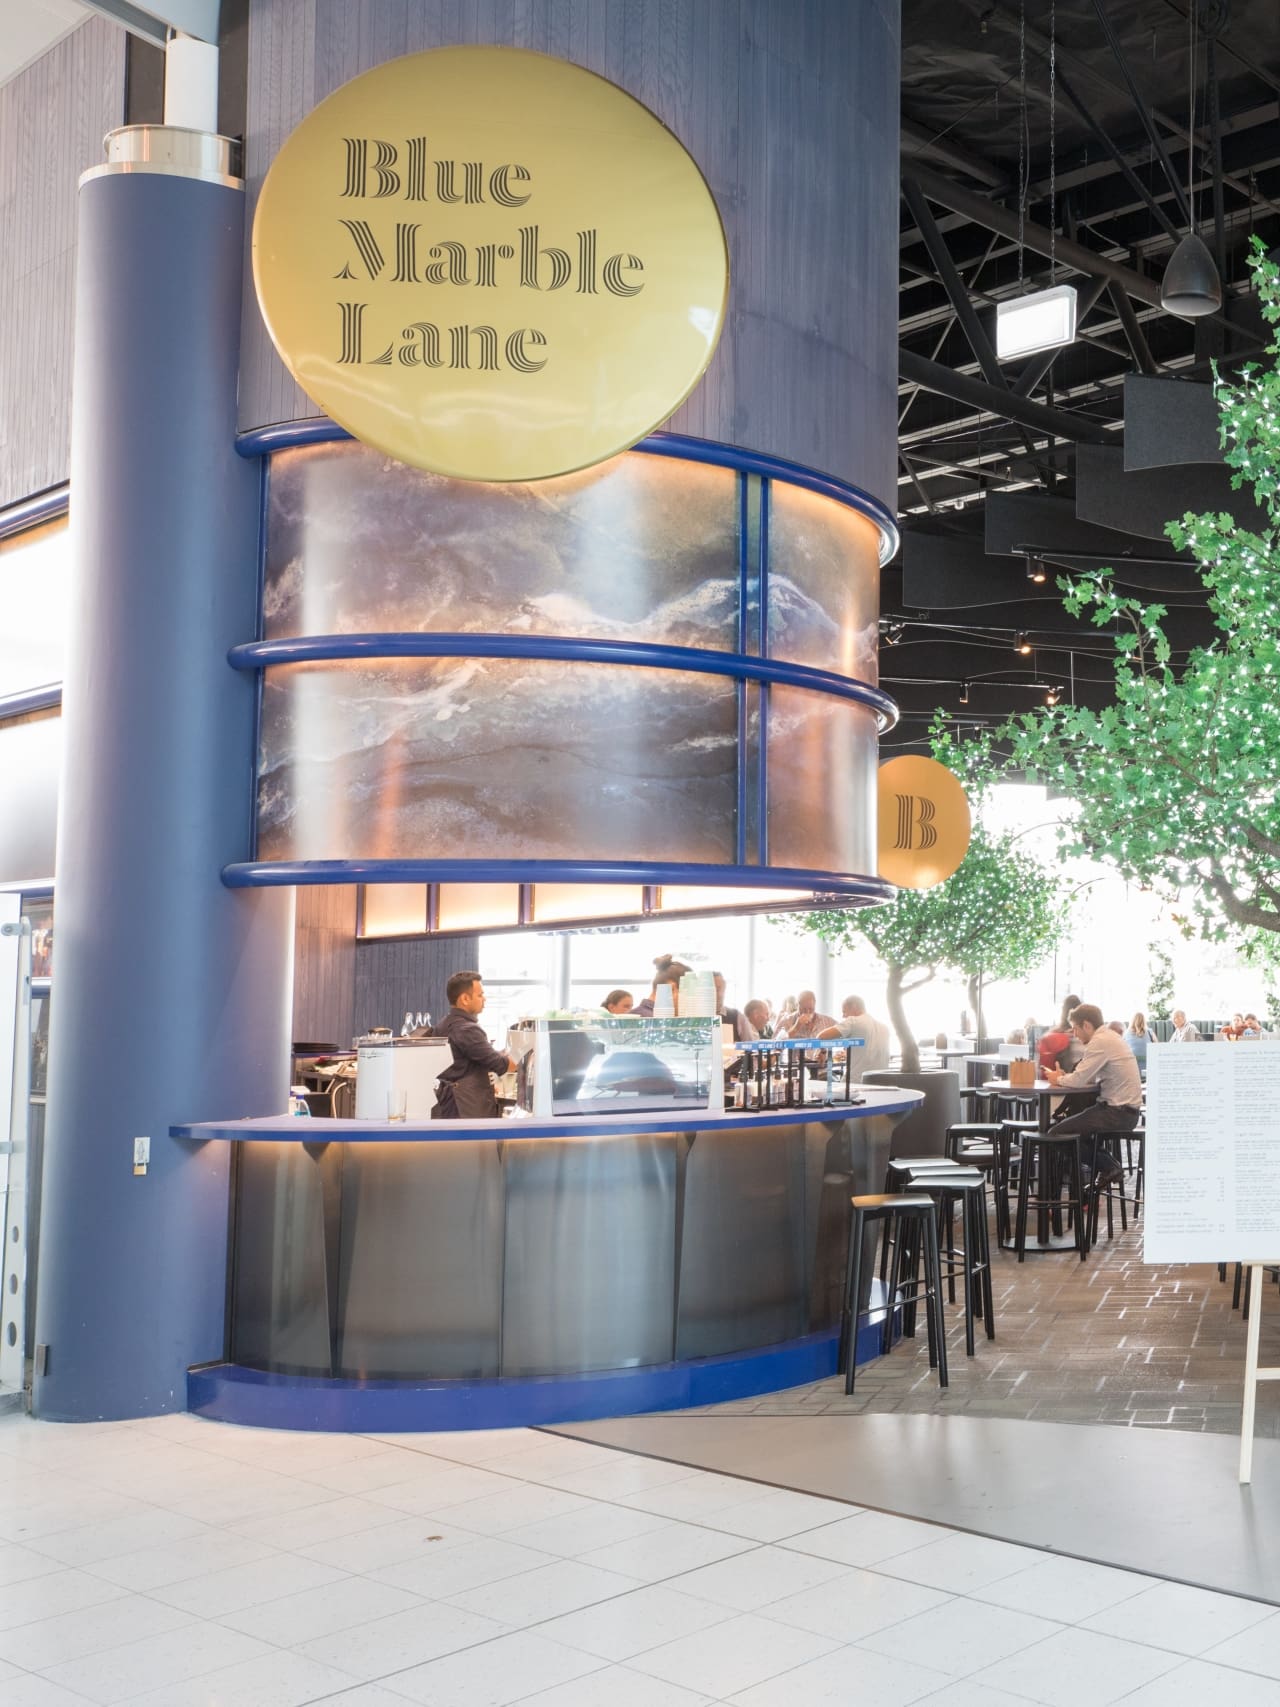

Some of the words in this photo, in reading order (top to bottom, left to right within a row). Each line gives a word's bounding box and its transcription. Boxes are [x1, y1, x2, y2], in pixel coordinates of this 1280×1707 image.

[339, 136, 533, 208] Blue
[332, 219, 646, 298] Marble
[335, 302, 549, 374] Lane
[892, 793, 938, 850] B
